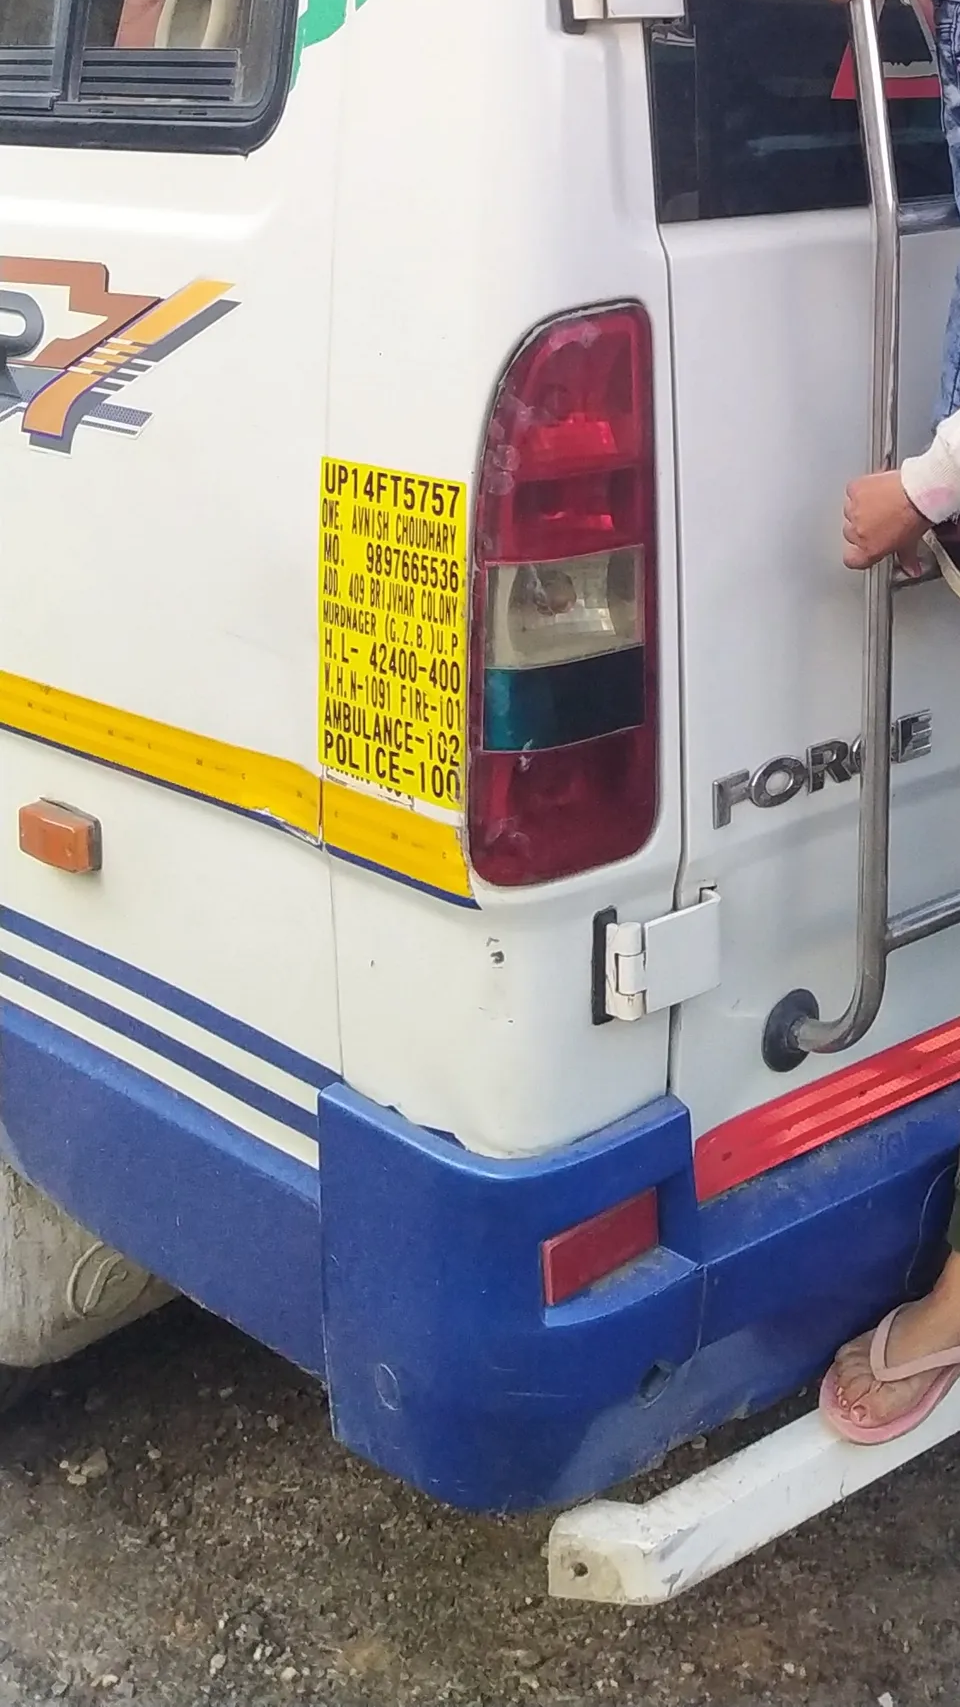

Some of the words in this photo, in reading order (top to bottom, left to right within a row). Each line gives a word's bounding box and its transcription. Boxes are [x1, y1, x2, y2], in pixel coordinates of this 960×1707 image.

[324, 461, 461, 519] UP14FT5757
[321, 497, 343, 532] OWE.
[351, 504, 390, 542] AVNISH
[395, 513, 458, 557] CHOUDHARY
[323, 532, 345, 567] MO.
[365, 541, 460, 594] 9897665536
[322, 599, 377, 638] MURDNAGER
[323, 564, 342, 599] ADD.
[348, 572, 365, 606] 409
[369, 576, 416, 619] BRIJVHAR
[420, 588, 459, 628] COLONY
[369, 641, 461, 695] 42400-400
[323, 696, 460, 767] AMBULANCE-102
[400, 683, 461, 732] FIRE-101
[323, 728, 461, 803] POLICE-100
[711, 708, 933, 830] FORE
